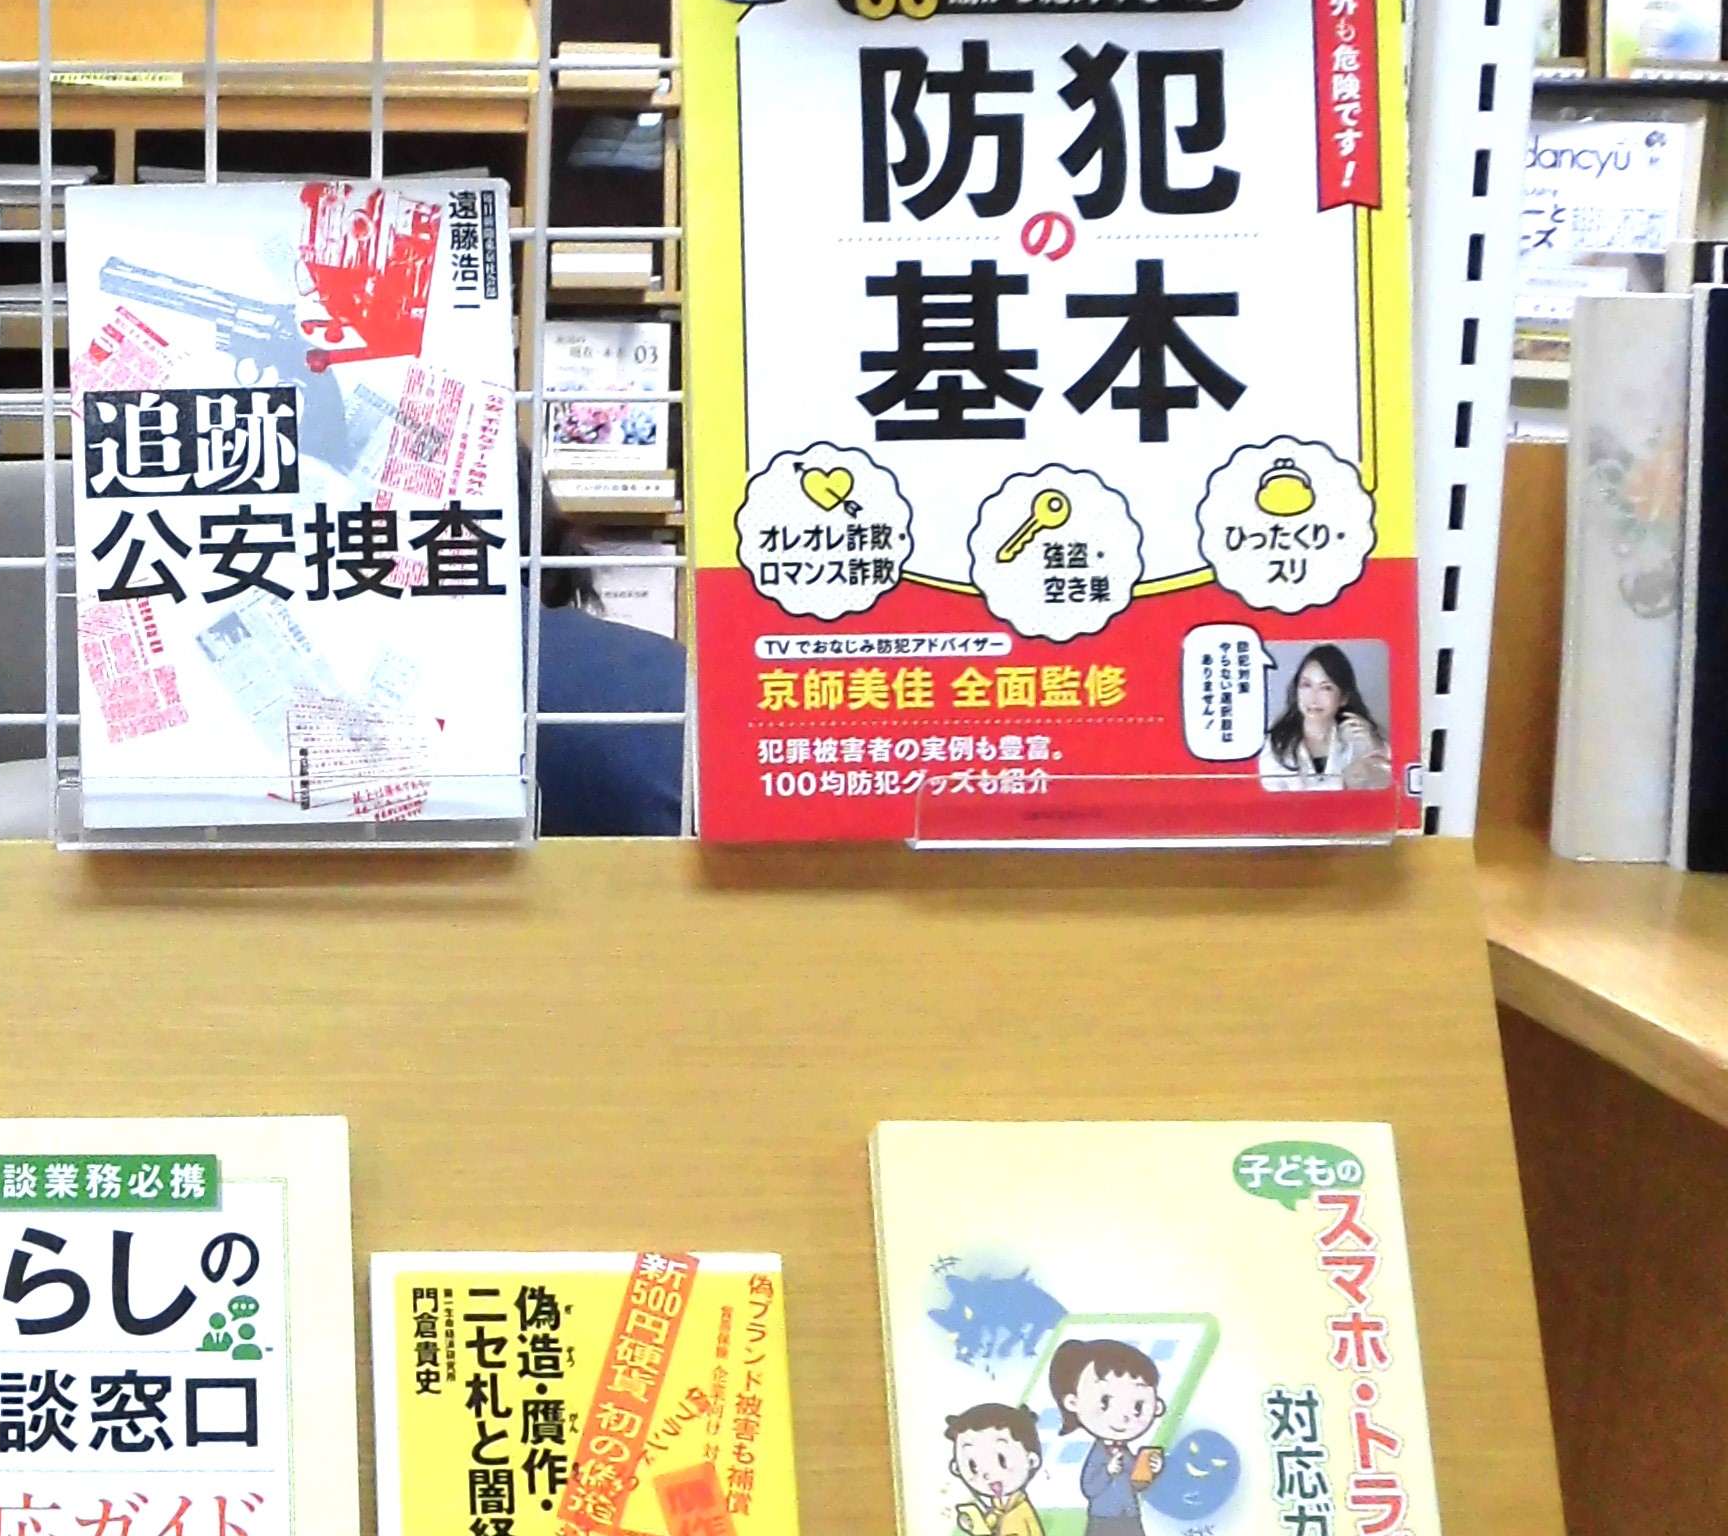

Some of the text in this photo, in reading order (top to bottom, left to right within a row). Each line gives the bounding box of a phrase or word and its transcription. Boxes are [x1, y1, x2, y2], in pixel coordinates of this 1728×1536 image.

[859, 40, 1241, 223] 防犯
[1526, 134, 1631, 178] dancyu
[448, 191, 480, 309] 遠藤浩二
[1021, 211, 1076, 262] の
[856, 259, 1248, 443] 基本
[87, 392, 297, 495] 追跡
[90, 501, 507, 605] 公安捜査
[759, 562, 897, 588] ロマンス詐欺
[1269, 559, 1308, 583] スリ
[1043, 576, 1111, 604] 空き巣
[757, 665, 1127, 710] 京師美佳 全面監修
[757, 735, 1064, 765] 犯罪被害者の実例も豊富。
[761, 769, 1051, 799] 100均防犯グッズも紹介
[1239, 1153, 1363, 1189] 子どもの
[413, 1287, 442, 1396] 門倉貴史
